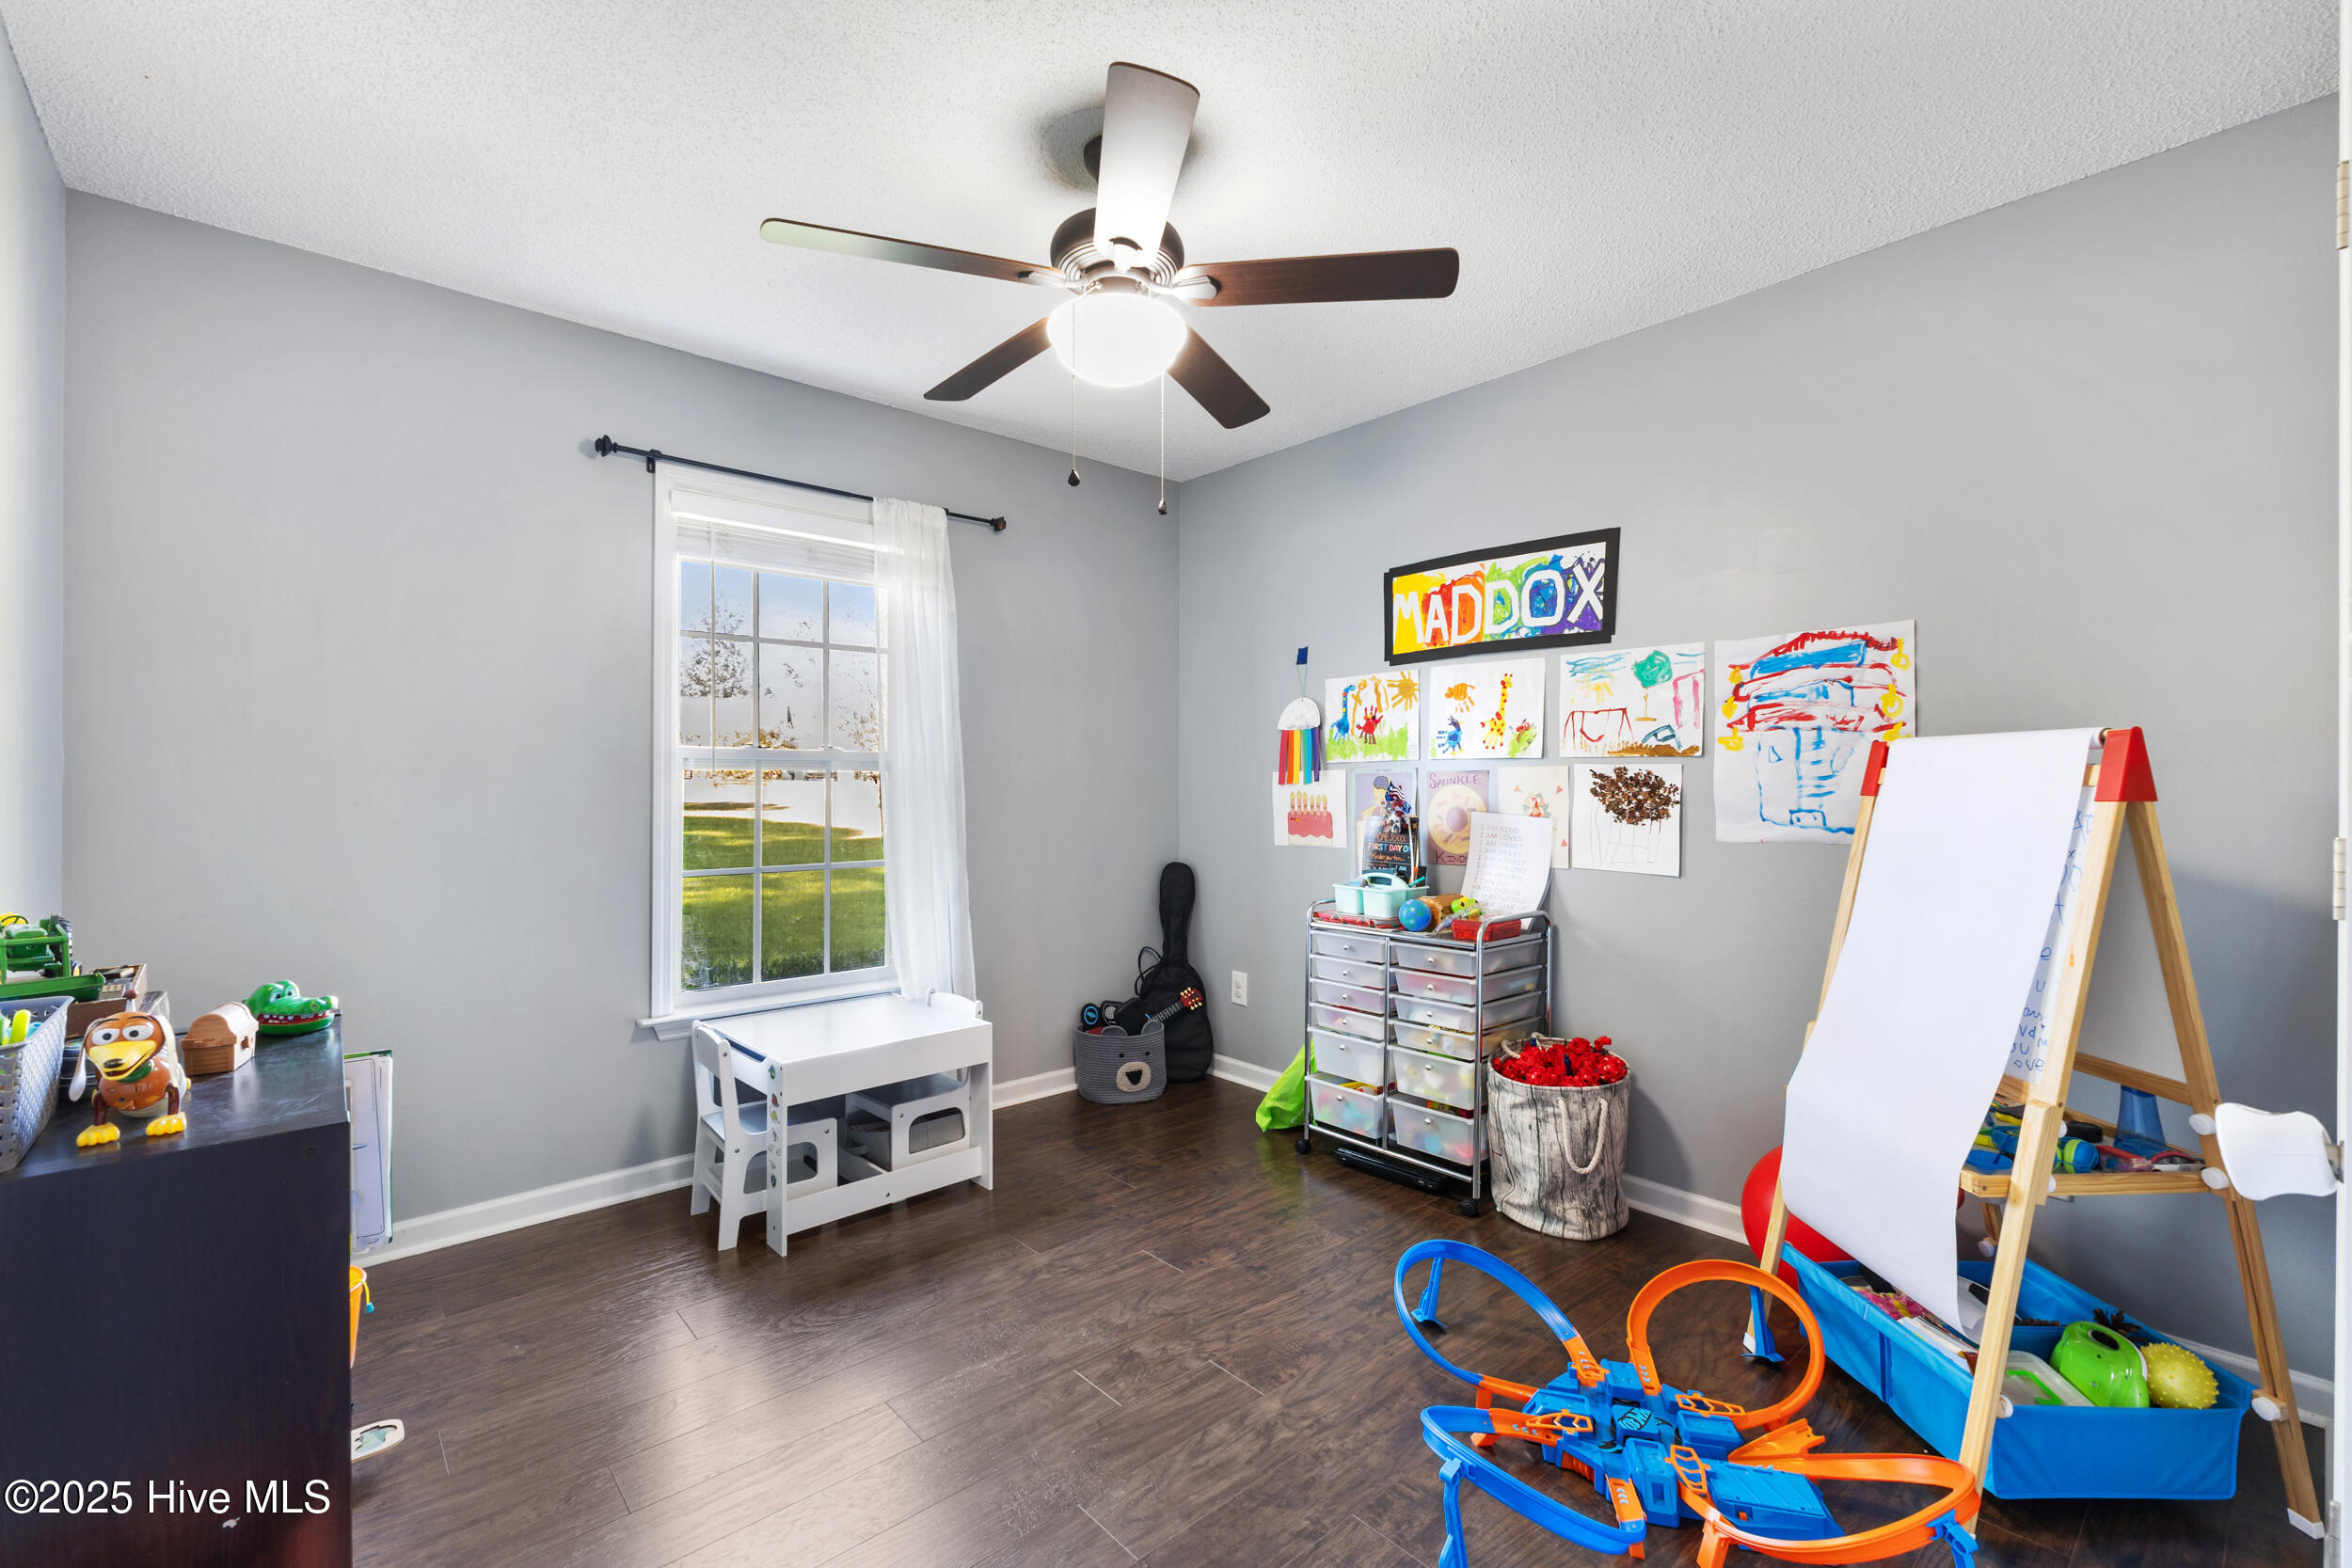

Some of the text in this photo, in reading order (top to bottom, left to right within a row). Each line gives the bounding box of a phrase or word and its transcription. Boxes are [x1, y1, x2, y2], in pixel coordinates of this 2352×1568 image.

[1392, 562, 1605, 646] MADDOX
[1368, 842, 1388, 851] FIRST
[1389, 843, 1403, 852] DAY
